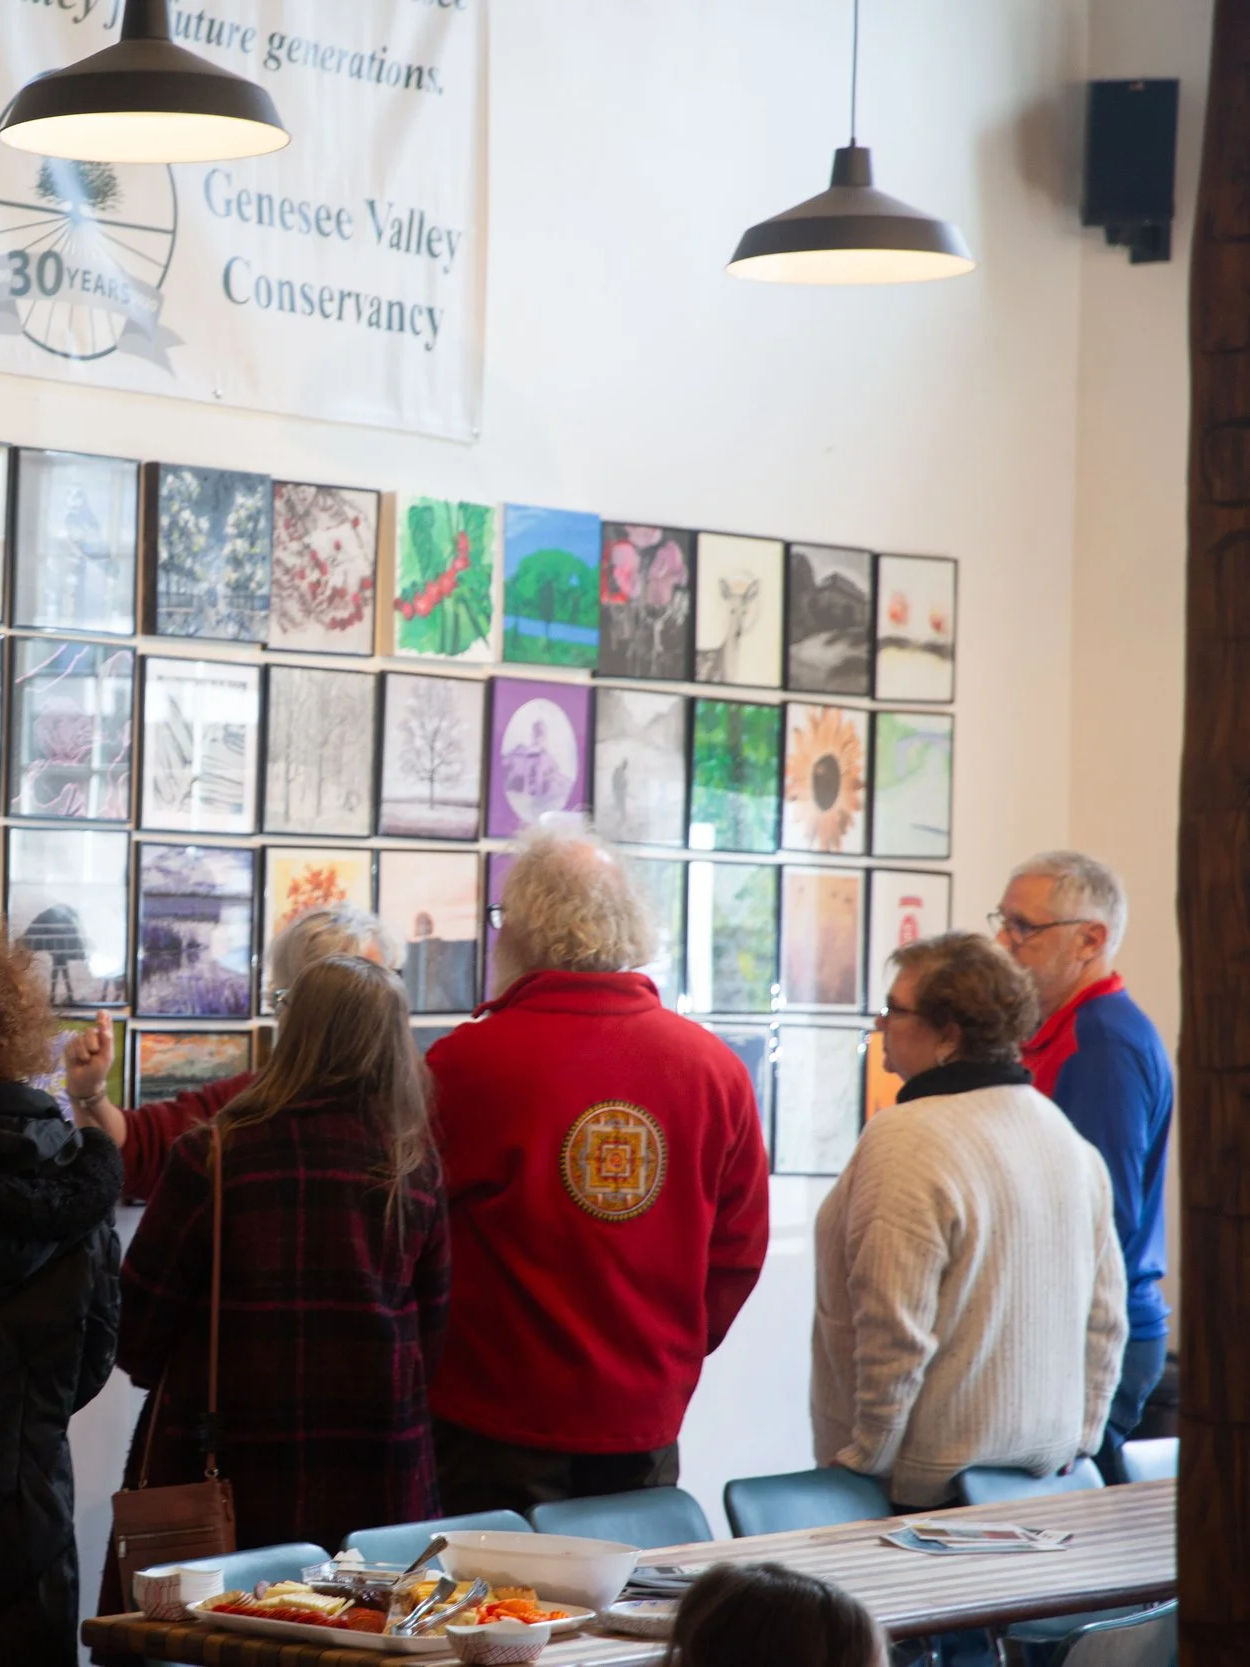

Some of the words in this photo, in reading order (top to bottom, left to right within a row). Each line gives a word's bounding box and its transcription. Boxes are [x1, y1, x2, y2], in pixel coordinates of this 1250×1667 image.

[172, 2, 257, 54] uture
[263, 31, 444, 96] generations.
[203, 167, 354, 241] Genesee
[365, 198, 462, 275] Valley
[7, 249, 64, 297] 30
[65, 266, 132, 305] YEARS
[222, 255, 445, 352] Conservancy
